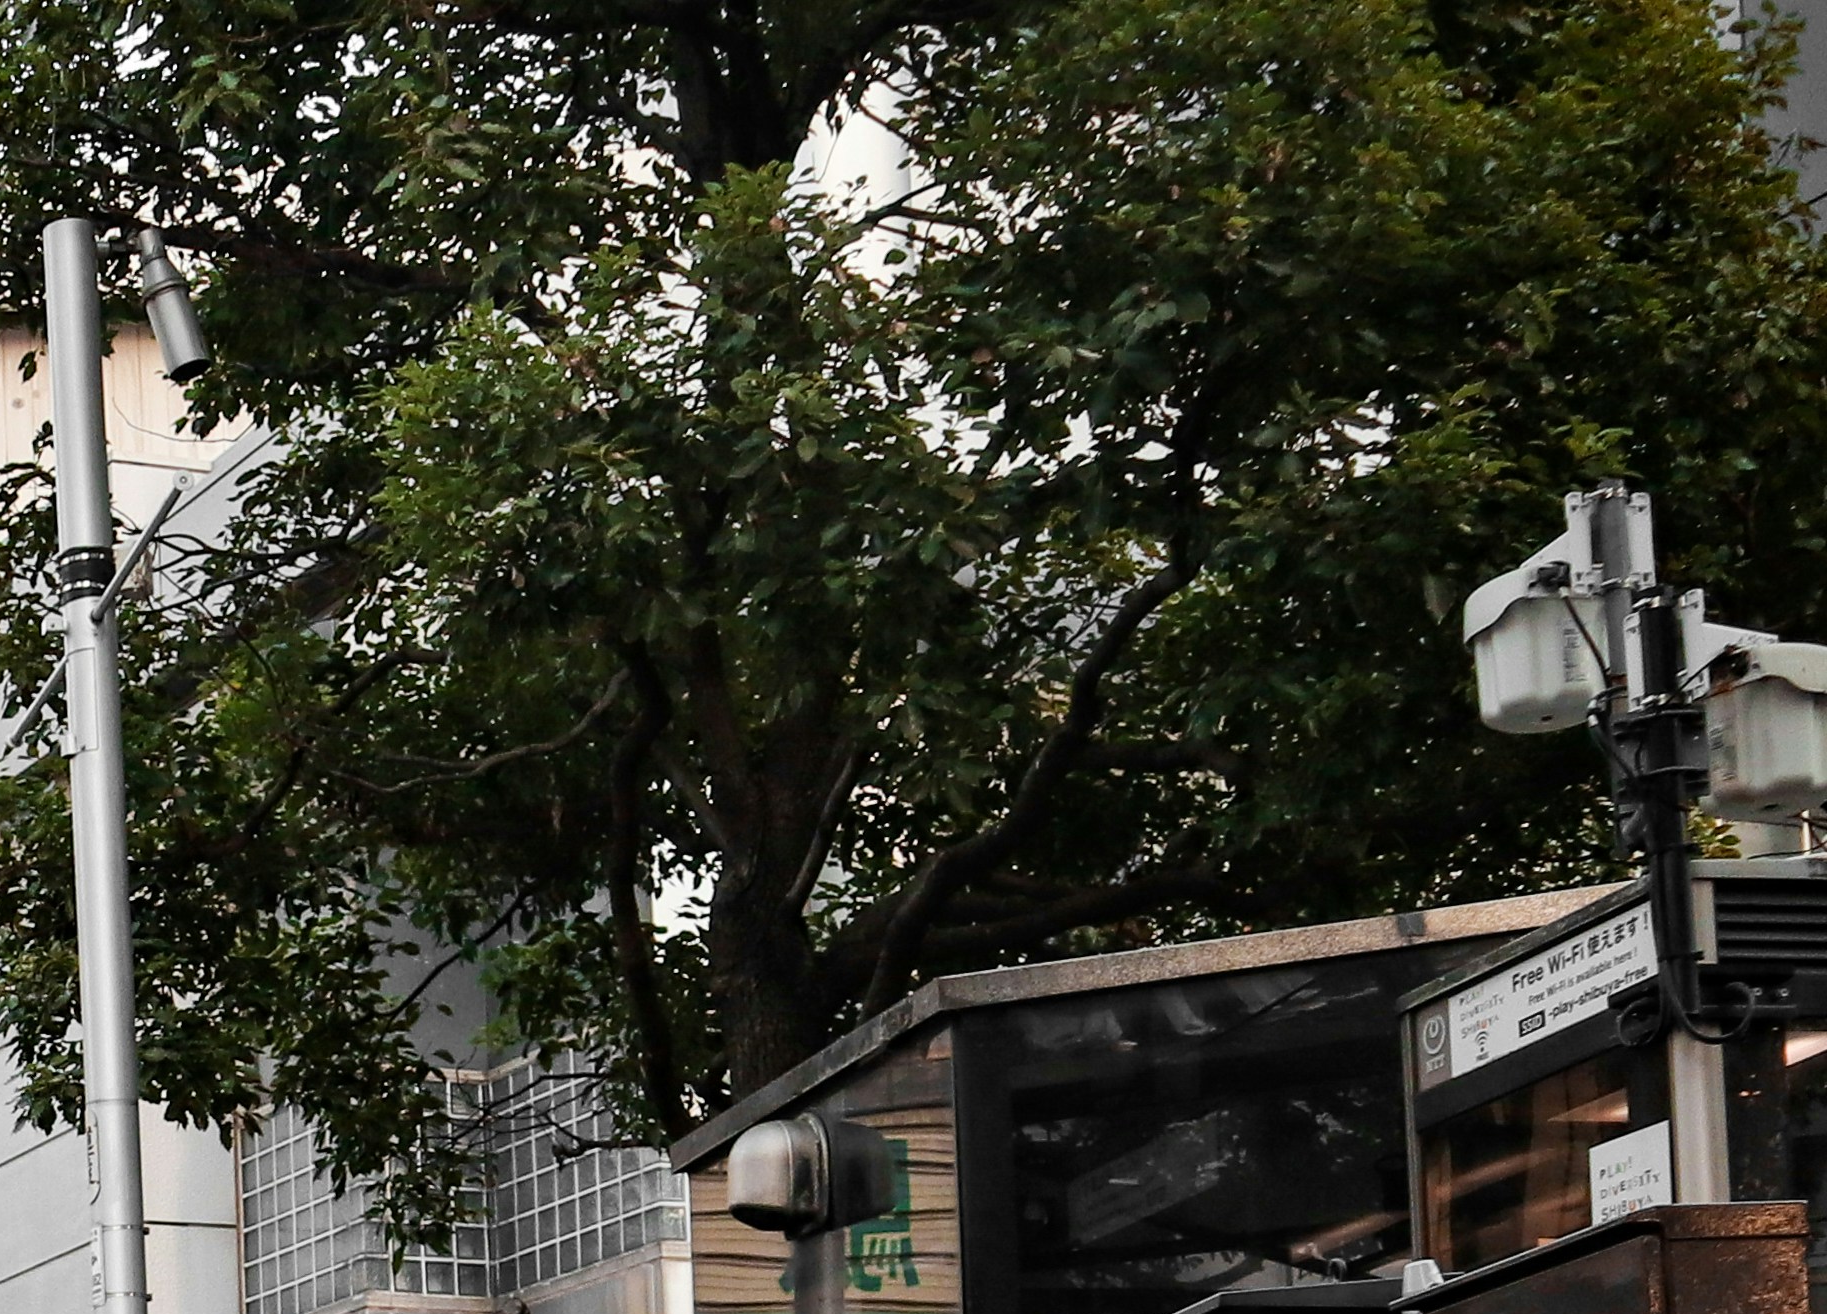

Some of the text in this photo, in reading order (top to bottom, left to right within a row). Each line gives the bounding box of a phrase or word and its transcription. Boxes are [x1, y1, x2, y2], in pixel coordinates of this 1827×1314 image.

[1512, 966, 1544, 993] Free
[1547, 941, 1586, 975] Wi-Fi
[1600, 1168, 1661, 1200] DIVERSITY
[1601, 1195, 1654, 1223] SHIBUYA
